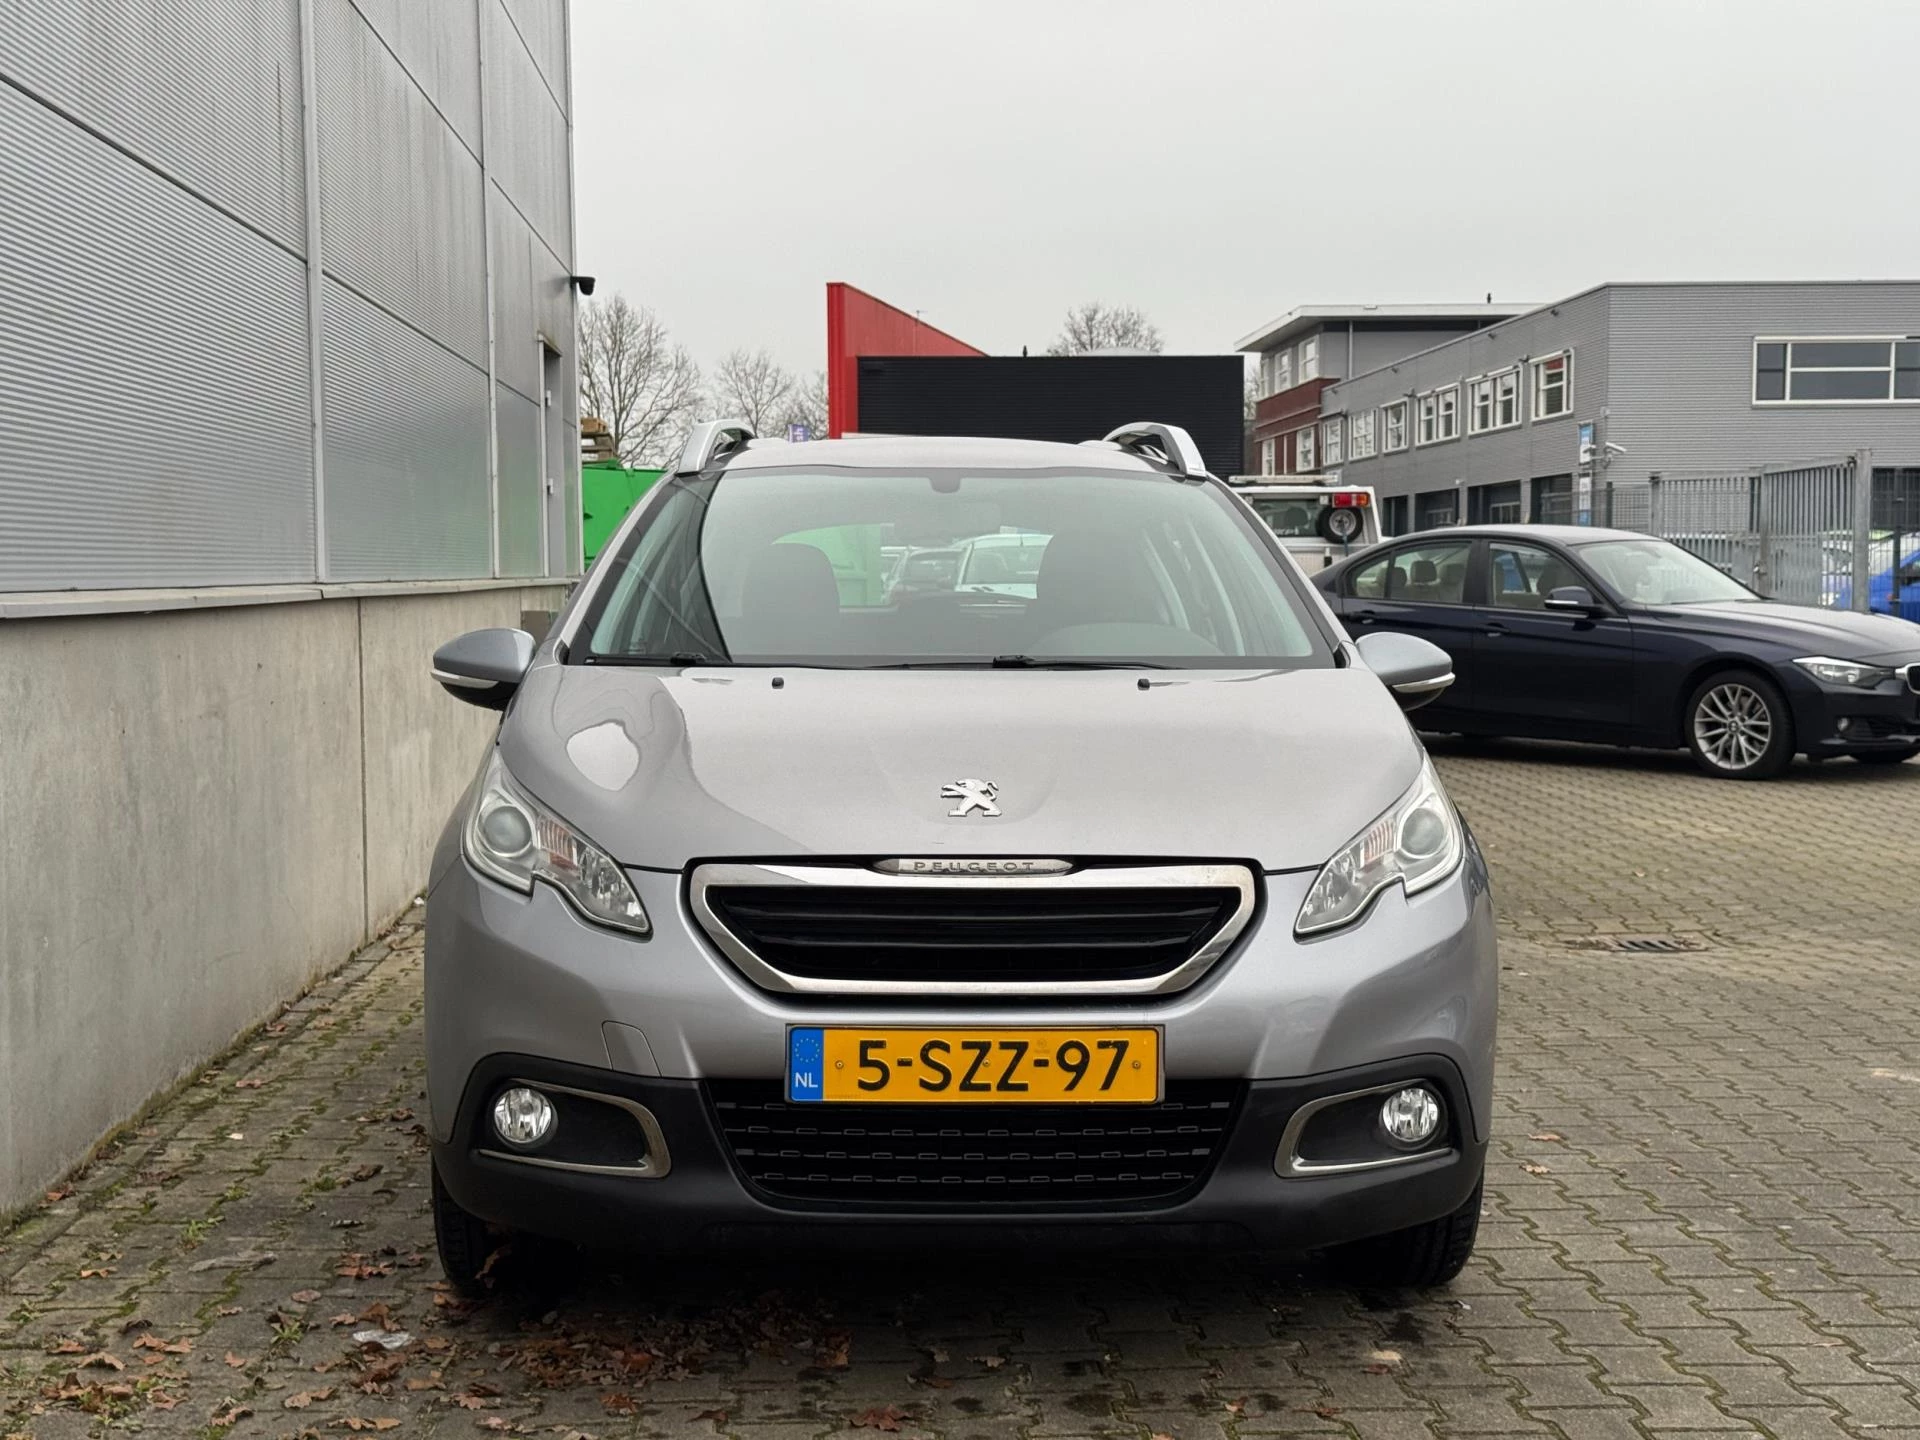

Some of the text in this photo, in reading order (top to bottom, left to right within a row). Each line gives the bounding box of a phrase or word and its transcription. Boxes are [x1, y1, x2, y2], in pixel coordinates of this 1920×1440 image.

[913, 861, 1035, 872] PEUGEOT
[857, 1039, 1130, 1092] 5-SZZ-97
[794, 1072, 818, 1089] NL
